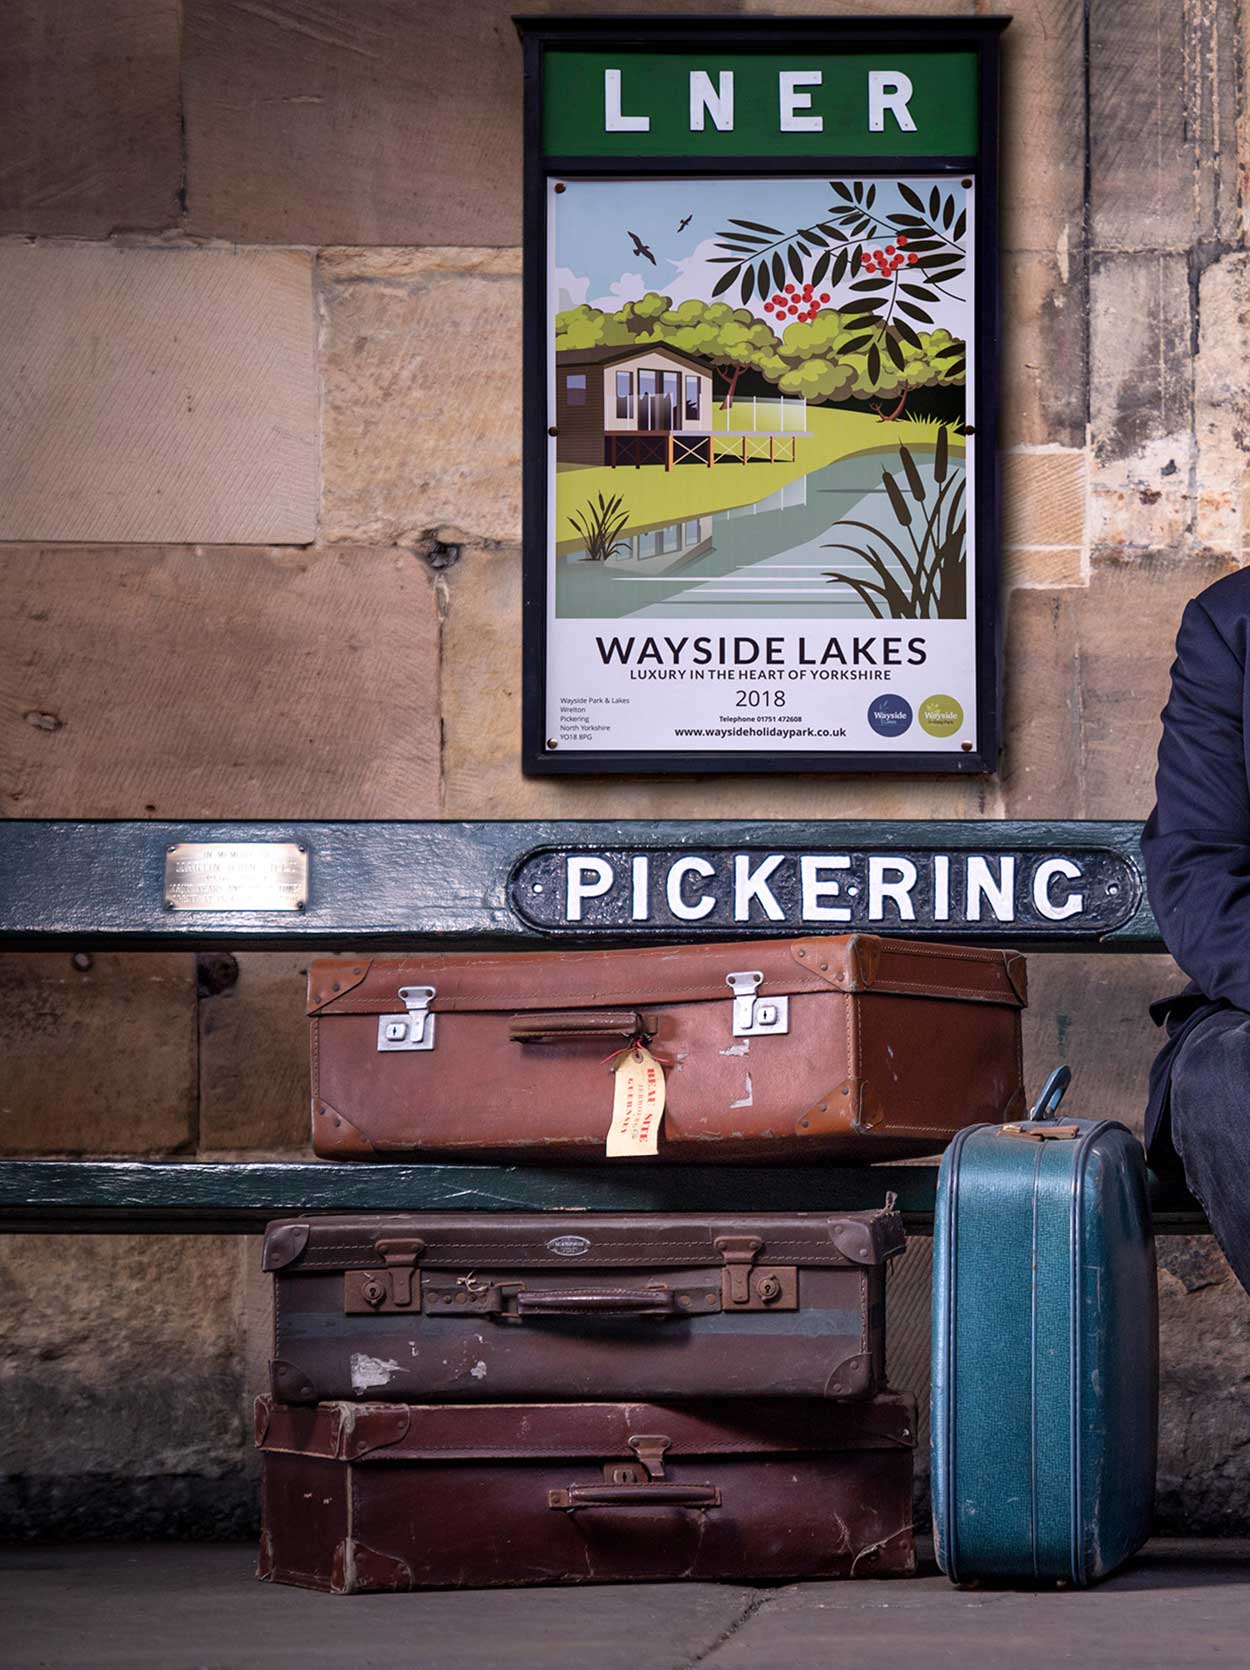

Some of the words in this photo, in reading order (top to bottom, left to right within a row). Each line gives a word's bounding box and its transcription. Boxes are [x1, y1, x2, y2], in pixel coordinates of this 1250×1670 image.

[604, 69, 918, 132] LNER
[595, 636, 785, 665] WAYSIDE
[799, 637, 927, 665] LAKES
[630, 669, 685, 680] LUXURY
[690, 669, 704, 680] IN
[708, 669, 735, 680] THE
[739, 669, 785, 680] HEART
[788, 669, 807, 680] OF
[810, 669, 891, 681] YORKSHIRE
[560, 697, 587, 705] Wayside
[735, 690, 786, 707] 2018
[560, 715, 589, 723] Pickering
[719, 715, 755, 723] Telephone
[757, 715, 776, 723] 01751
[778, 715, 802, 723] 472608
[873, 711, 907, 720] Wayside
[924, 711, 958, 720] Wayside
[674, 727, 847, 739] www.waysideholidaypark.co.uk
[565, 854, 1085, 923] PICKERING
